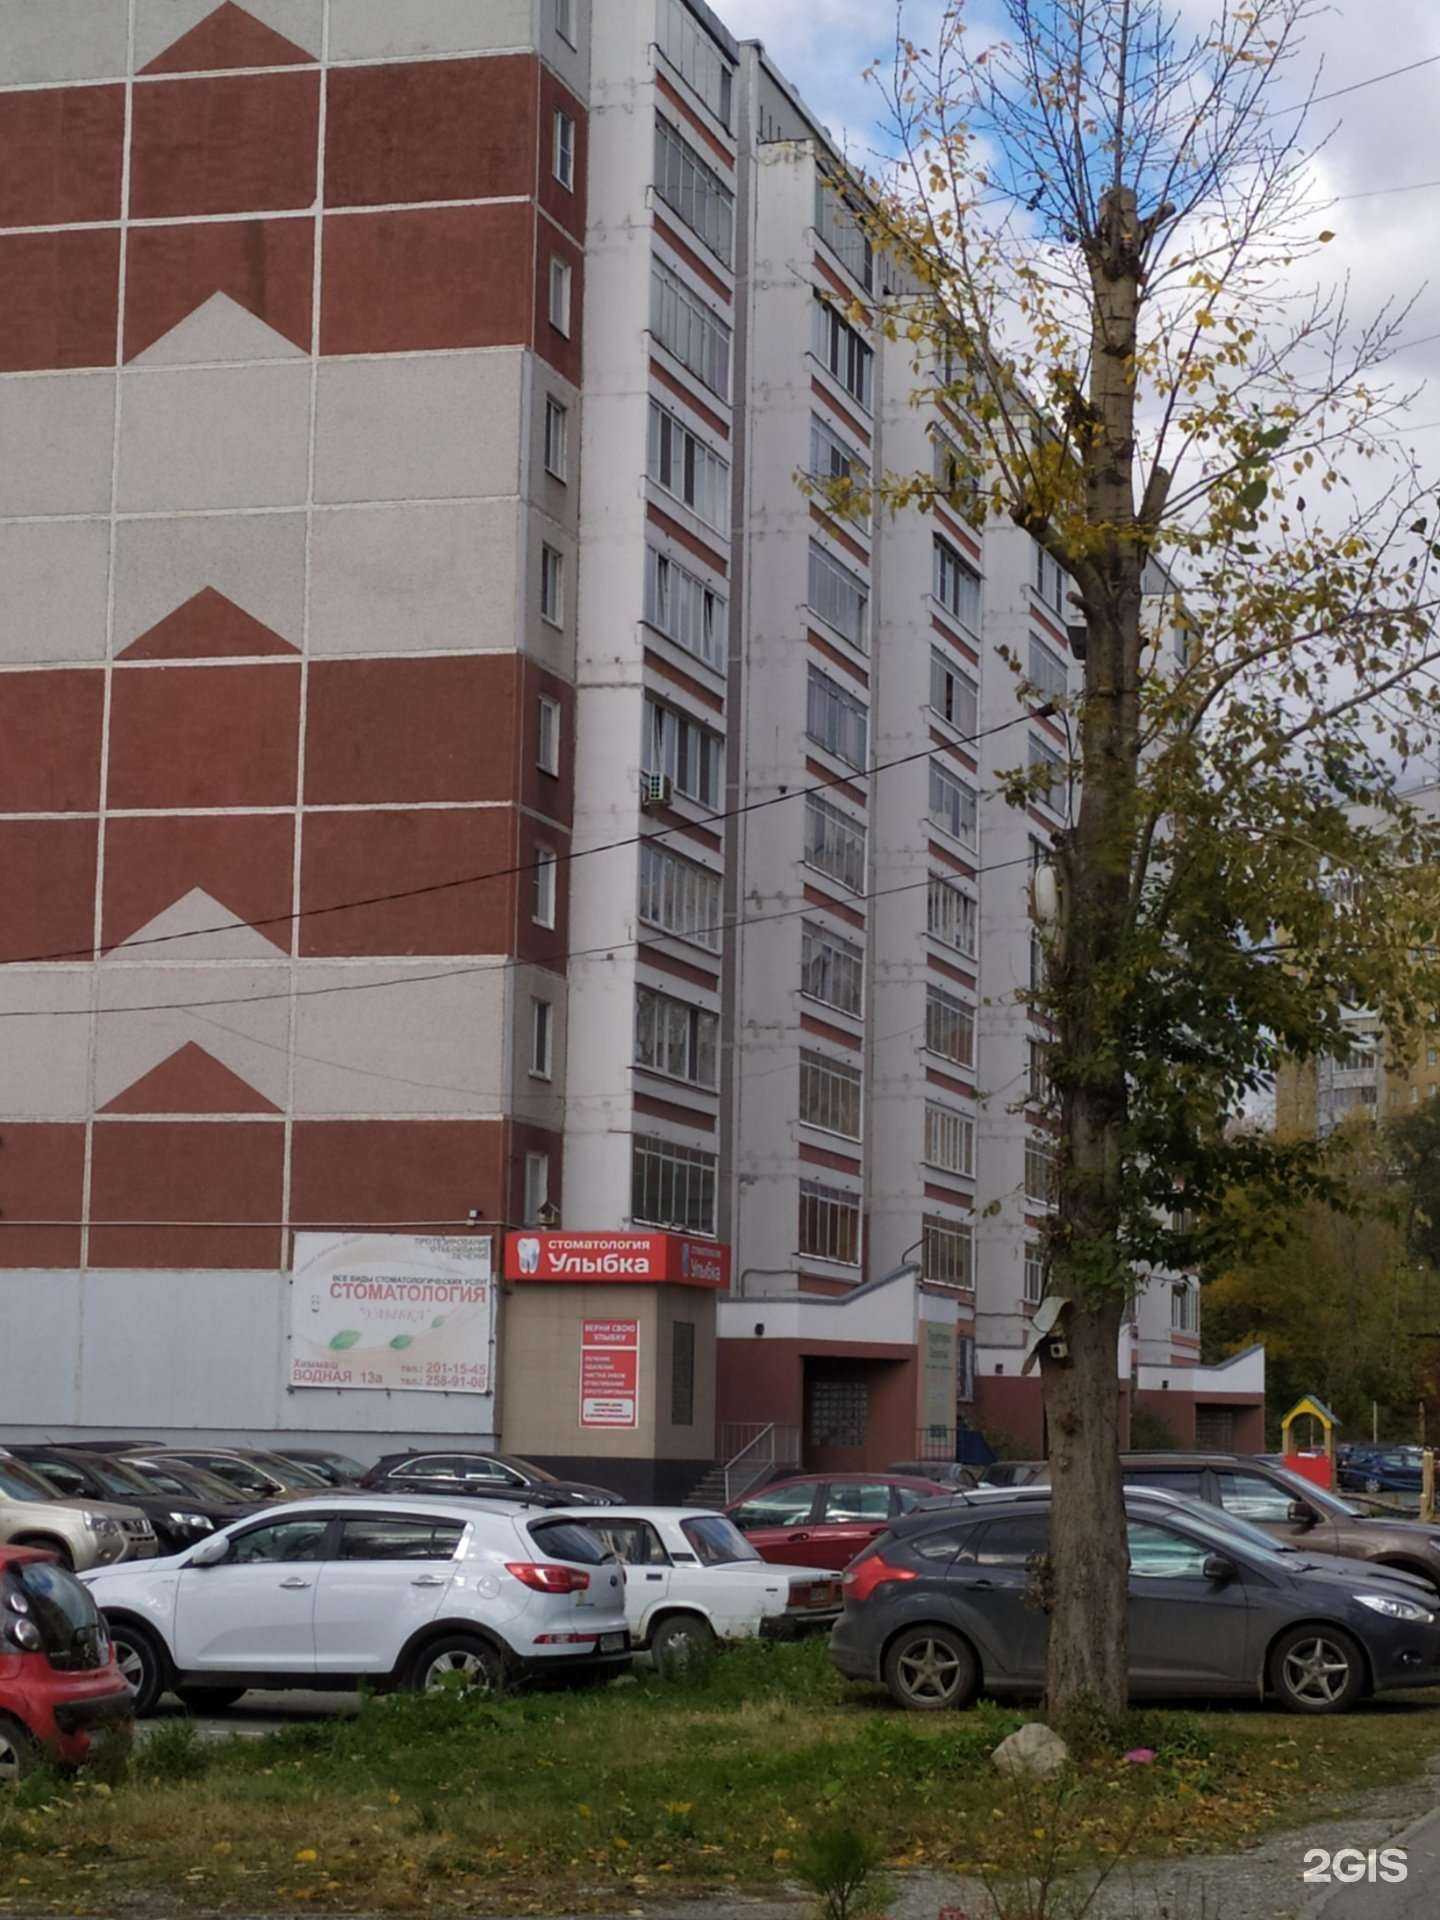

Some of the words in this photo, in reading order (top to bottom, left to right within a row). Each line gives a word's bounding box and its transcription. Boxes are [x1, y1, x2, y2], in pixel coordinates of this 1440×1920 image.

[548, 1239, 650, 1250] стоматология
[548, 1253, 650, 1273] Улыбка
[350, 1275, 373, 1283] ВИДЫ
[375, 1276, 463, 1285] СТОМАТОЛОГИЧЕСКИХ
[329, 1283, 486, 1303] СТОМАТОЛОГИЯ
[293, 1369, 352, 1383] ВОДНАЯ
[426, 1363, 486, 1376] 201-15-45
